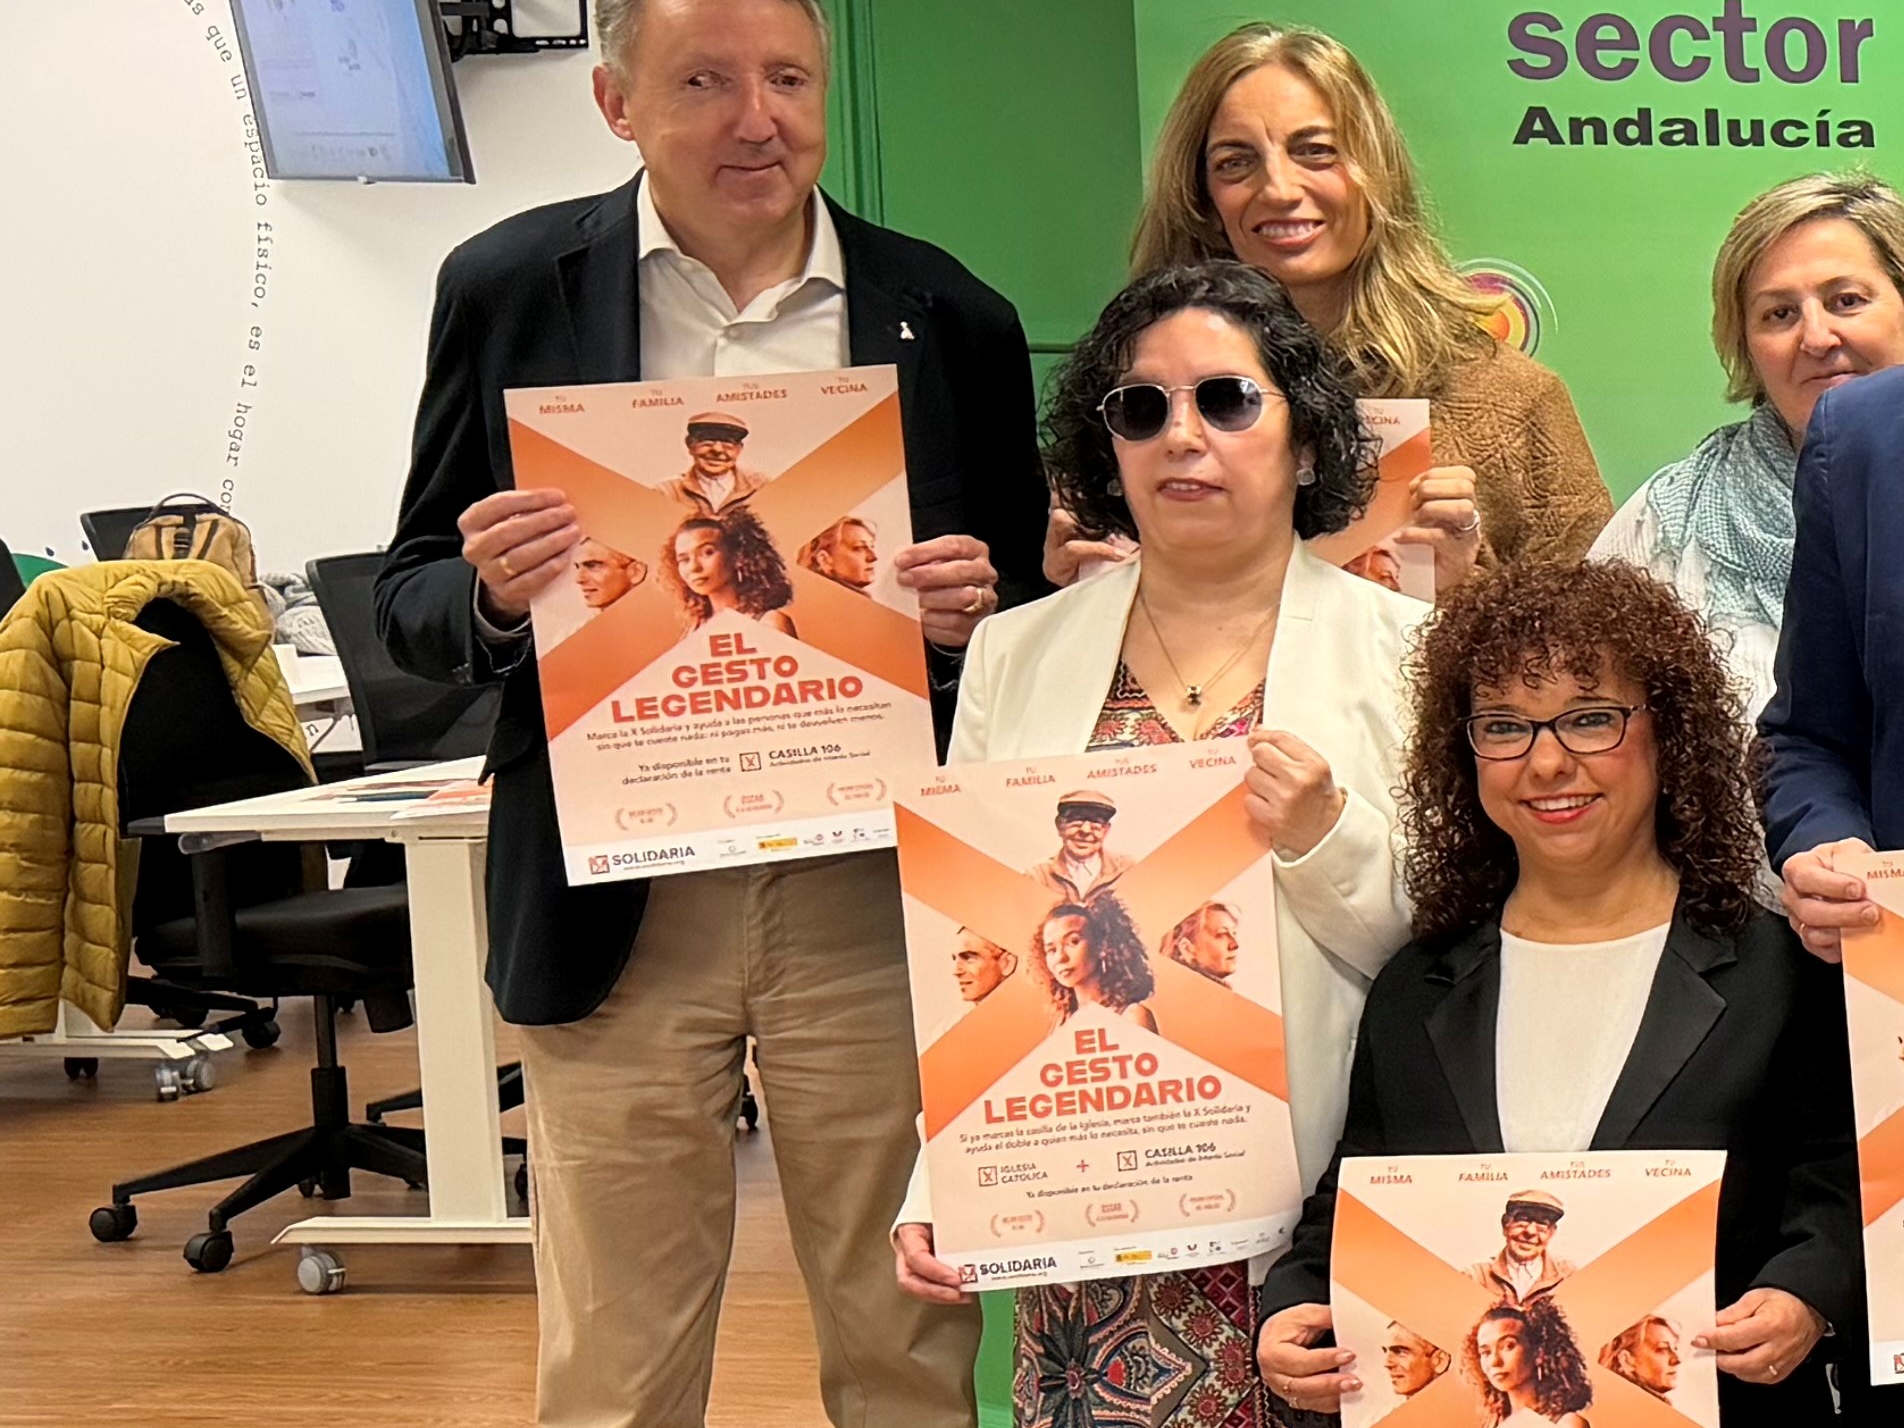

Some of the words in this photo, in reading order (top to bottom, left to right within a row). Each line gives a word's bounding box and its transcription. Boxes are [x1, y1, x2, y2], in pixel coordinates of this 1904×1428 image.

[205, 25, 233, 63] que
[230, 73, 247, 100] un
[1512, 104, 1876, 148] Andalucía
[242, 114, 270, 206] espacio
[251, 222, 273, 308] físico,
[248, 325, 263, 351] es
[241, 364, 257, 387] el
[226, 402, 252, 467] hogar
[709, 632, 756, 656] EL
[671, 654, 798, 688] GESTO
[610, 674, 864, 723] LEGENDARIO
[610, 845, 696, 867] SOLIDARIA
[1074, 1027, 1118, 1053] EL
[1039, 1052, 1159, 1087] GESTO
[982, 1075, 1222, 1123] LEGENDARIO
[1458, 1172, 1509, 1183] FAMILIA
[979, 1257, 1057, 1275] SOLIDARIA
